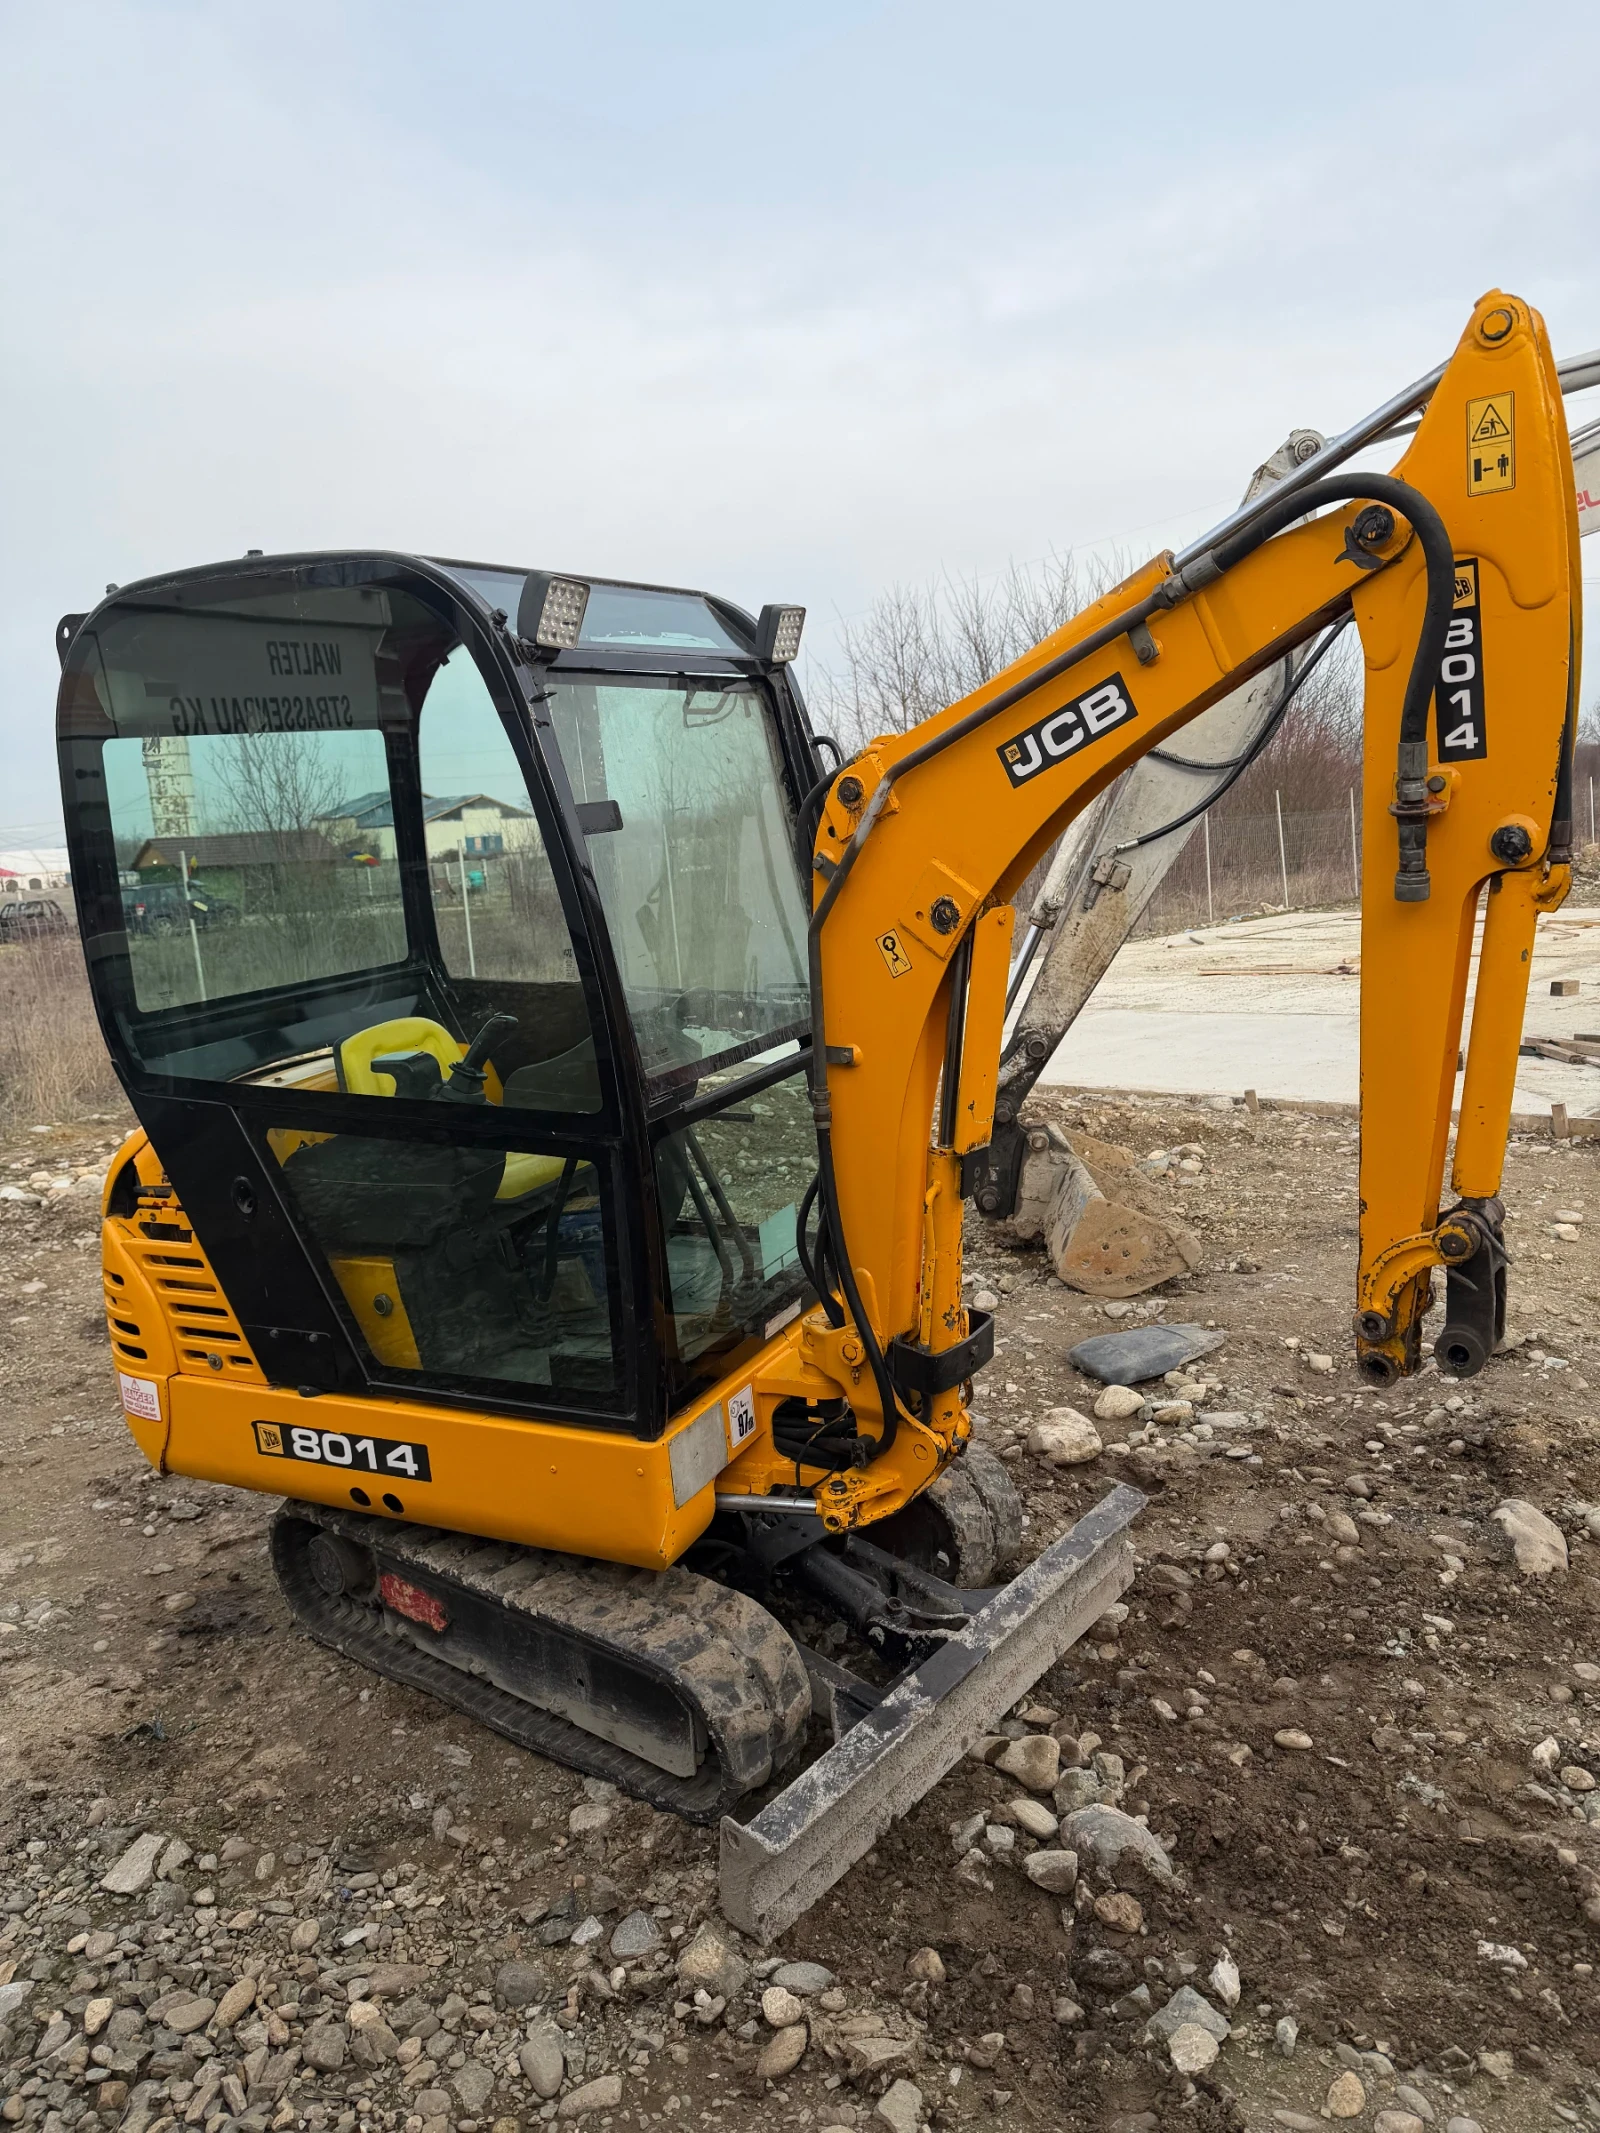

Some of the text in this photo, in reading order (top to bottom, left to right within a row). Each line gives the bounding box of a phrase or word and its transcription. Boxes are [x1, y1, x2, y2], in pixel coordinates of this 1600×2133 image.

[1454, 579, 1470, 599] CB
[1012, 684, 1128, 777] JCB
[263, 1430, 280, 1446] JCB
[290, 1427, 419, 1476] 8014
